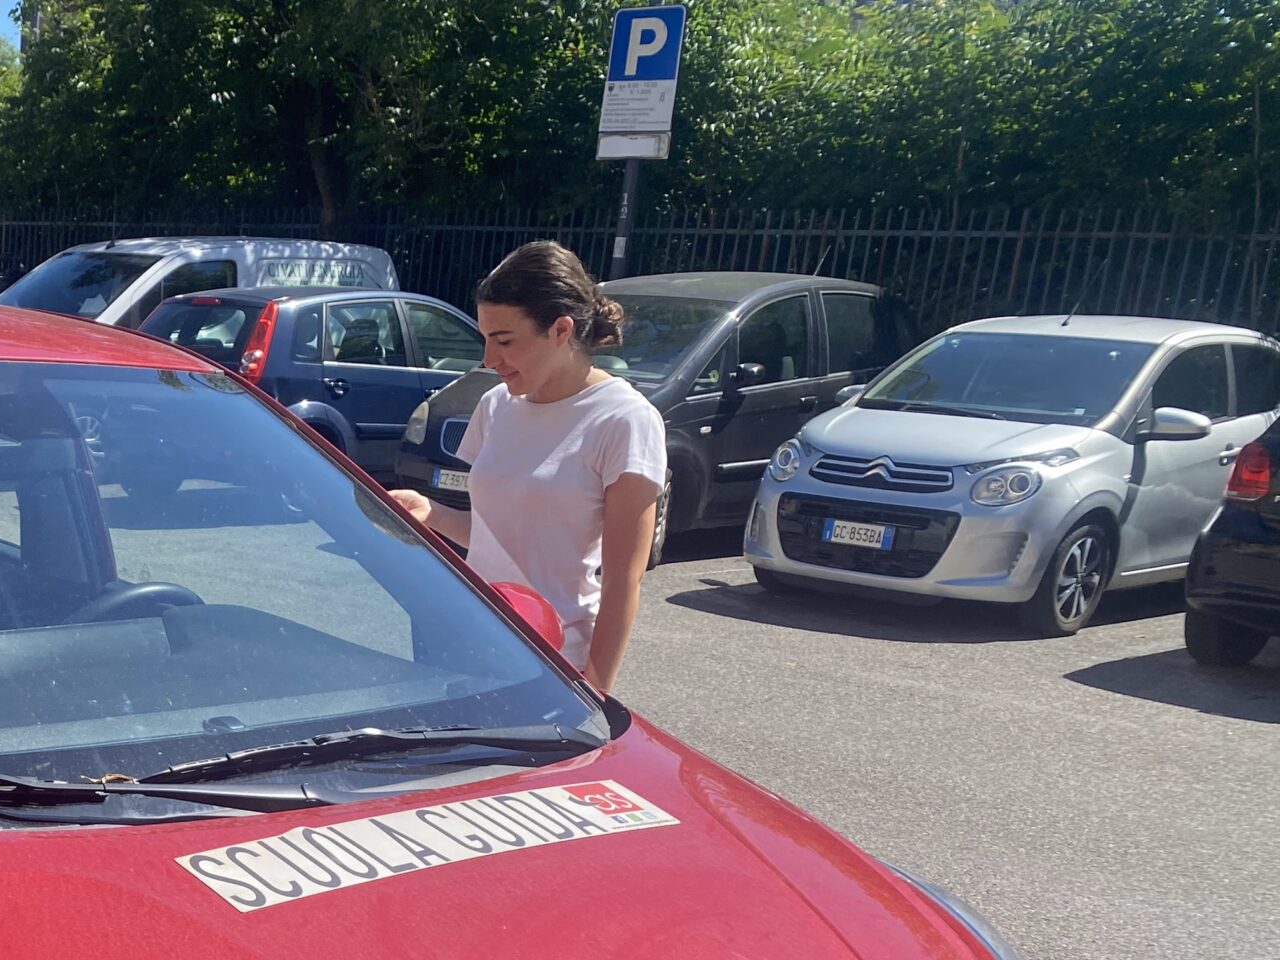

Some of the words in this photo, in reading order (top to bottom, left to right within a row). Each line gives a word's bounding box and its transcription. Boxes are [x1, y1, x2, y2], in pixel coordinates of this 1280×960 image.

[624, 16, 669, 77] P
[188, 818, 440, 908] SCUOLA
[416, 791, 609, 854] GUIDA
